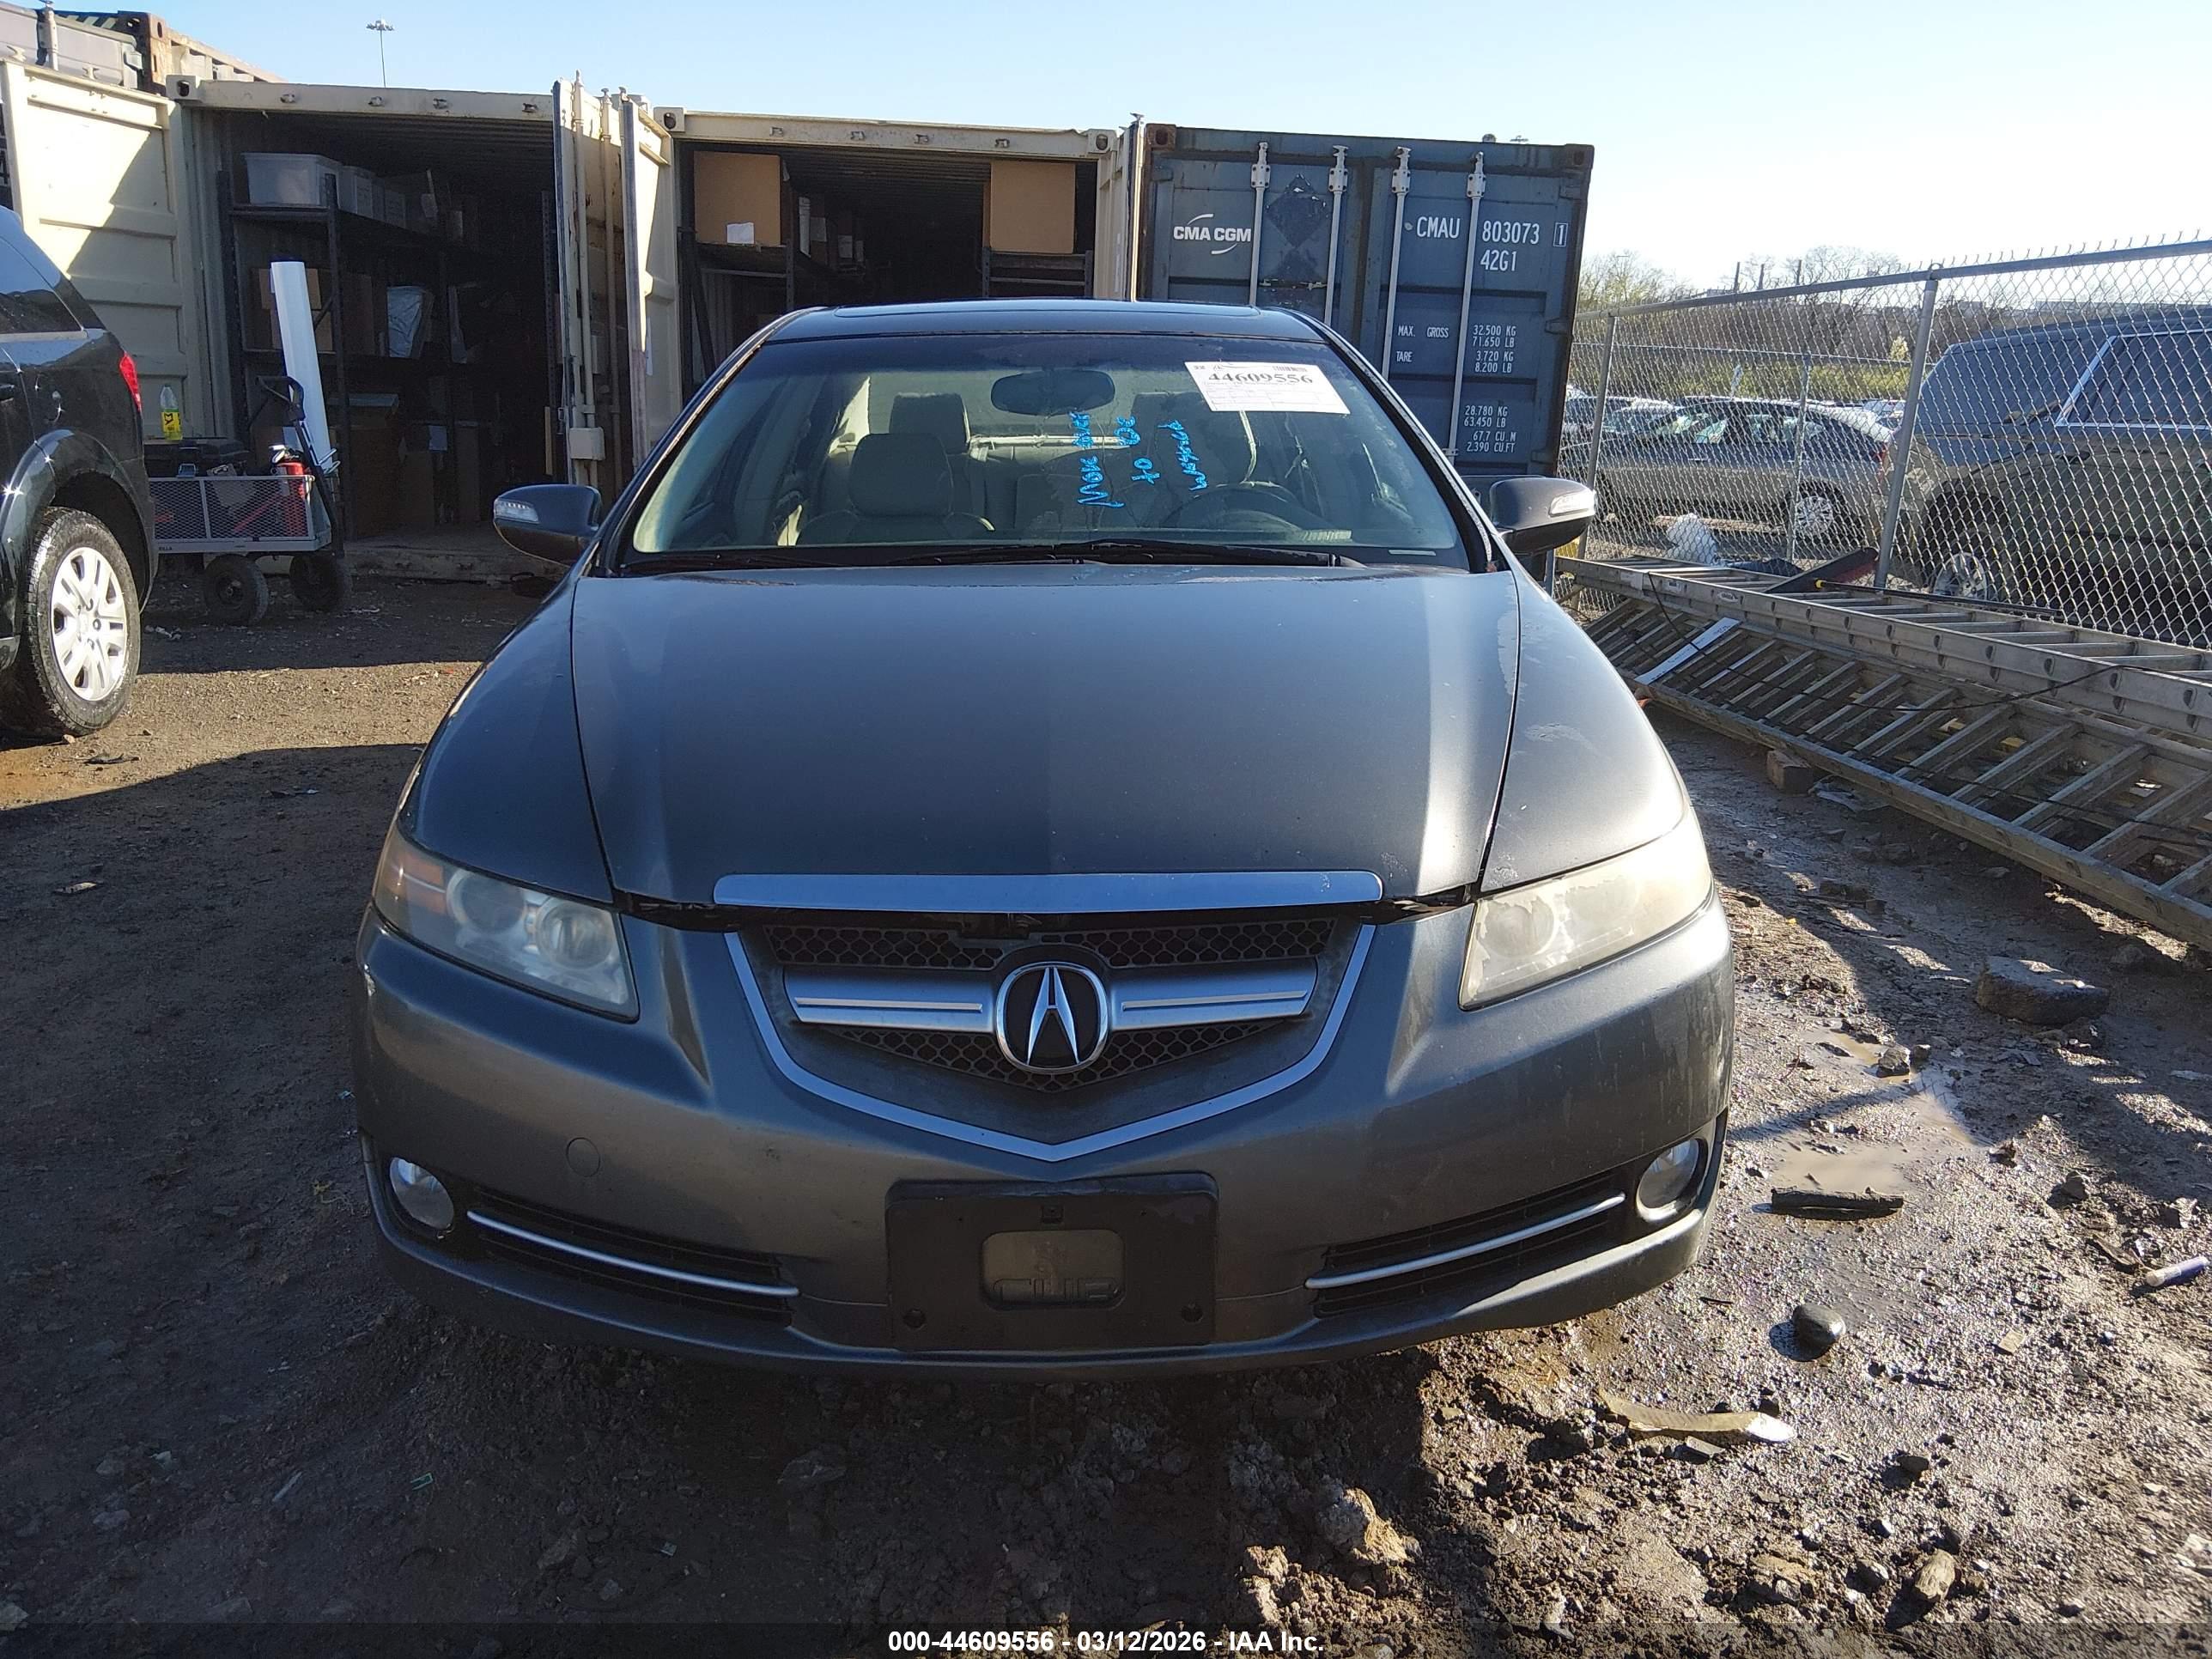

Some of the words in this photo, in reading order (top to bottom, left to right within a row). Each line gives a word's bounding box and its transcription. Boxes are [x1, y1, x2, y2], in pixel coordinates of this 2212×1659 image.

[1173, 226, 1211, 241] CMA
[1213, 228, 1252, 242] CGM
[1417, 216, 1461, 239] CMAU
[1482, 221, 1540, 245] 803073
[1480, 249, 1517, 271] 42G1
[1397, 325, 1416, 337] MAX.
[1426, 326, 1449, 338] GROSS
[1473, 325, 1501, 336] 32.500
[1505, 325, 1516, 337] KG
[1472, 337, 1500, 347] 71.650
[1504, 337, 1515, 348] LB
[1396, 351, 1413, 362] TARE
[1476, 350, 1499, 362] 3.720
[1504, 351, 1514, 362] KG
[1474, 362, 1498, 373] 8.200
[1502, 362, 1512, 374] LB
[1208, 373, 1313, 384] 44609556
[1465, 405, 1493, 416] 28.780
[1498, 406, 1508, 416] KG
[1464, 416, 1492, 427] 63.450
[1497, 417, 1506, 428] LB
[1473, 431, 1491, 441] 67.7
[1467, 441, 1490, 452] 2.390
[1131, 457, 1160, 484] to
